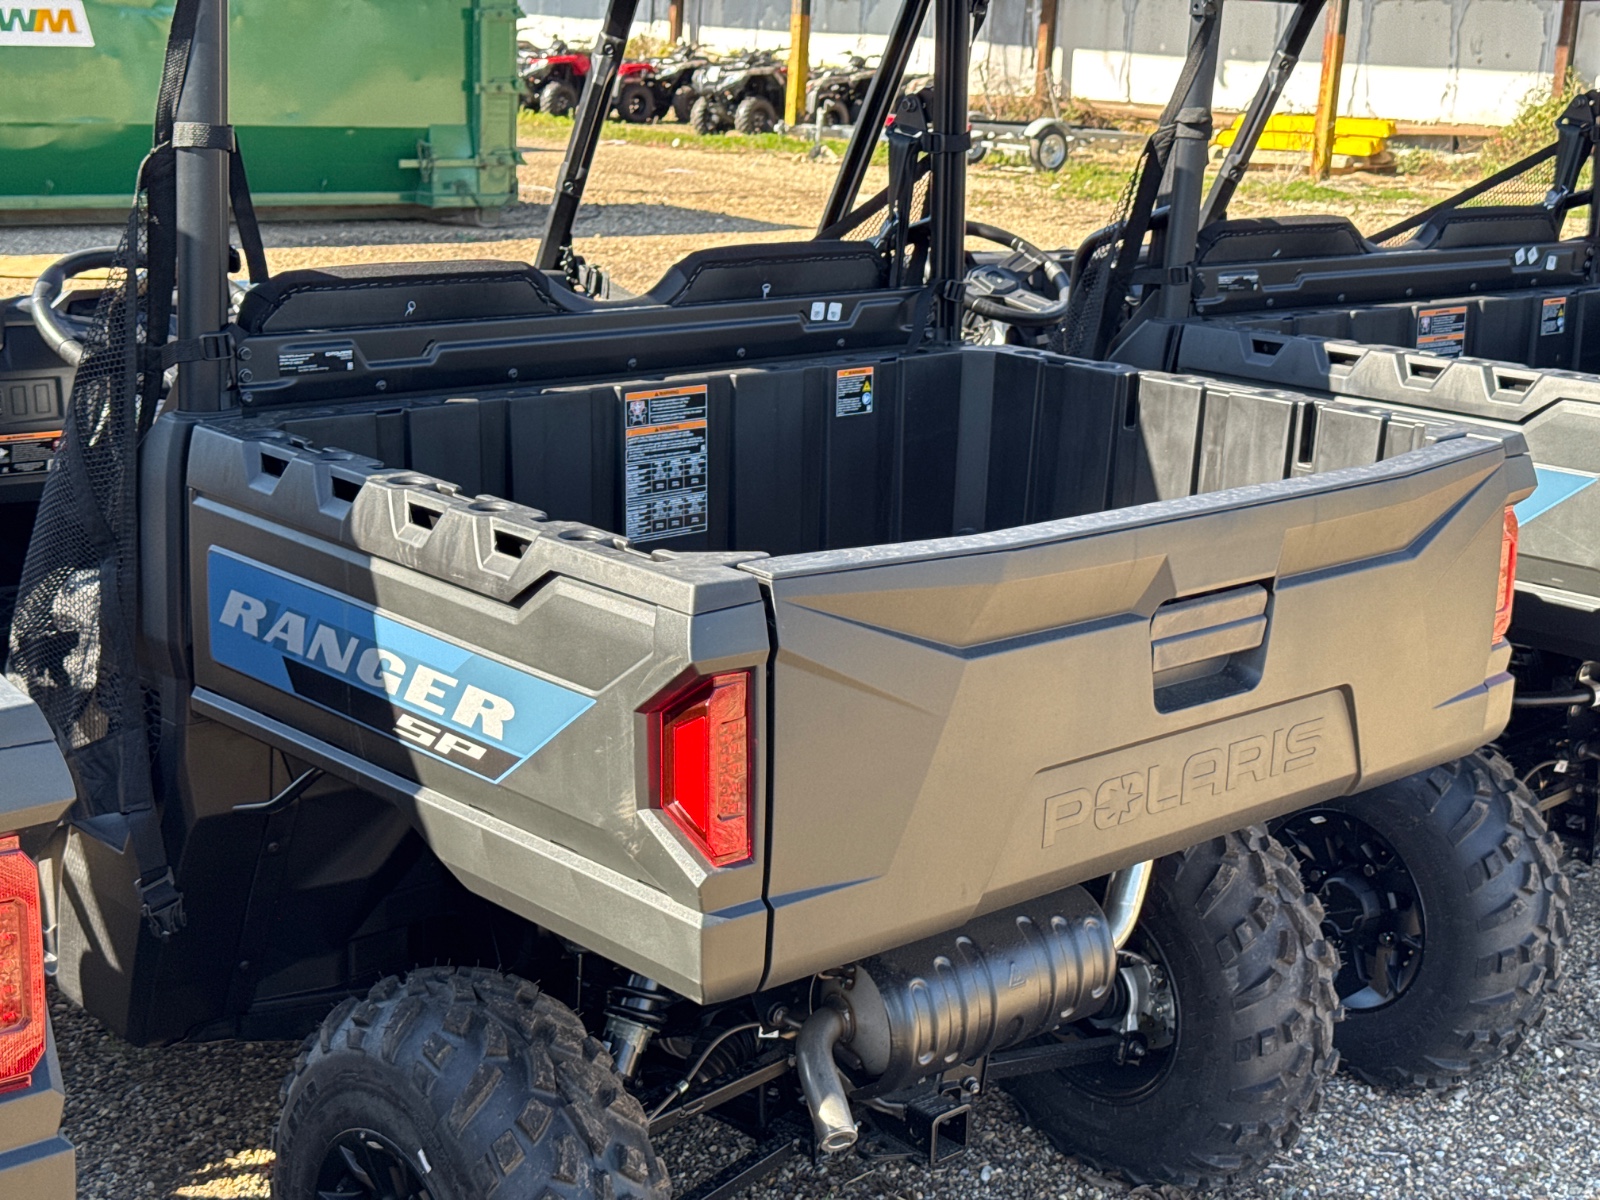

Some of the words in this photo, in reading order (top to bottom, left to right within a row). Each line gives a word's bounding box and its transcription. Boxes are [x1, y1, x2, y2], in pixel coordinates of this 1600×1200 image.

[0, 8, 77, 33] WM
[219, 589, 515, 741] RANGER
[393, 713, 487, 760] SP
[1041, 716, 1324, 849] POLARIS
